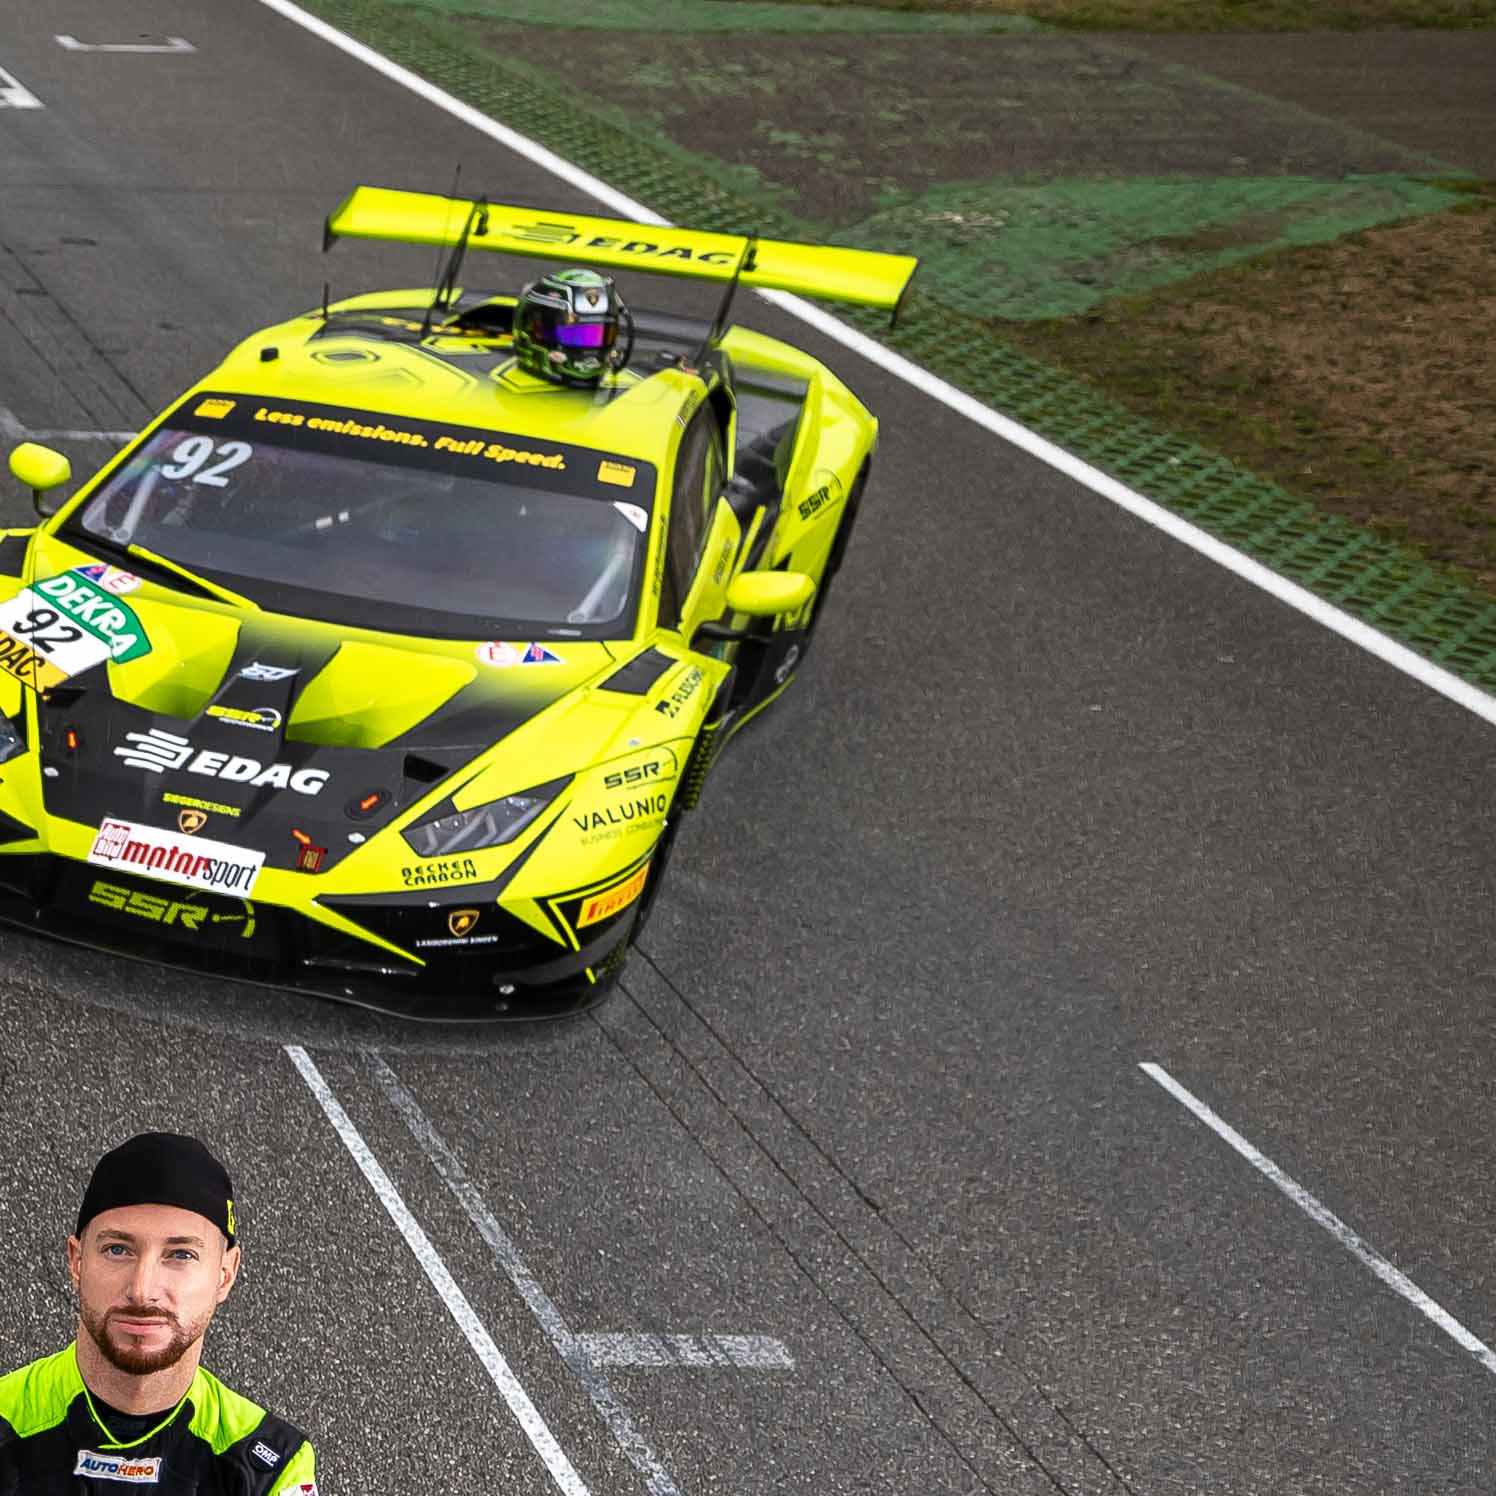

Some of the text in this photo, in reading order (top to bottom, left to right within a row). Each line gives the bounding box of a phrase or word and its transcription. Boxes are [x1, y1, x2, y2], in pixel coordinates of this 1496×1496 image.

[585, 235, 739, 266] EDAG
[253, 407, 567, 470] Less emissions. Full Speed.
[159, 435, 254, 488] 92
[11, 608, 84, 654] 92
[37, 574, 137, 658] DEKRA
[187, 750, 331, 795] EDAG
[603, 760, 661, 790] SSR
[121, 840, 257, 892] motorsport
[401, 858, 474, 878] BECKER
[403, 868, 478, 887] CARBON
[88, 880, 209, 931] SSR
[79, 1457, 156, 1477] AUTOHERO
[253, 1443, 279, 1466] OMP
